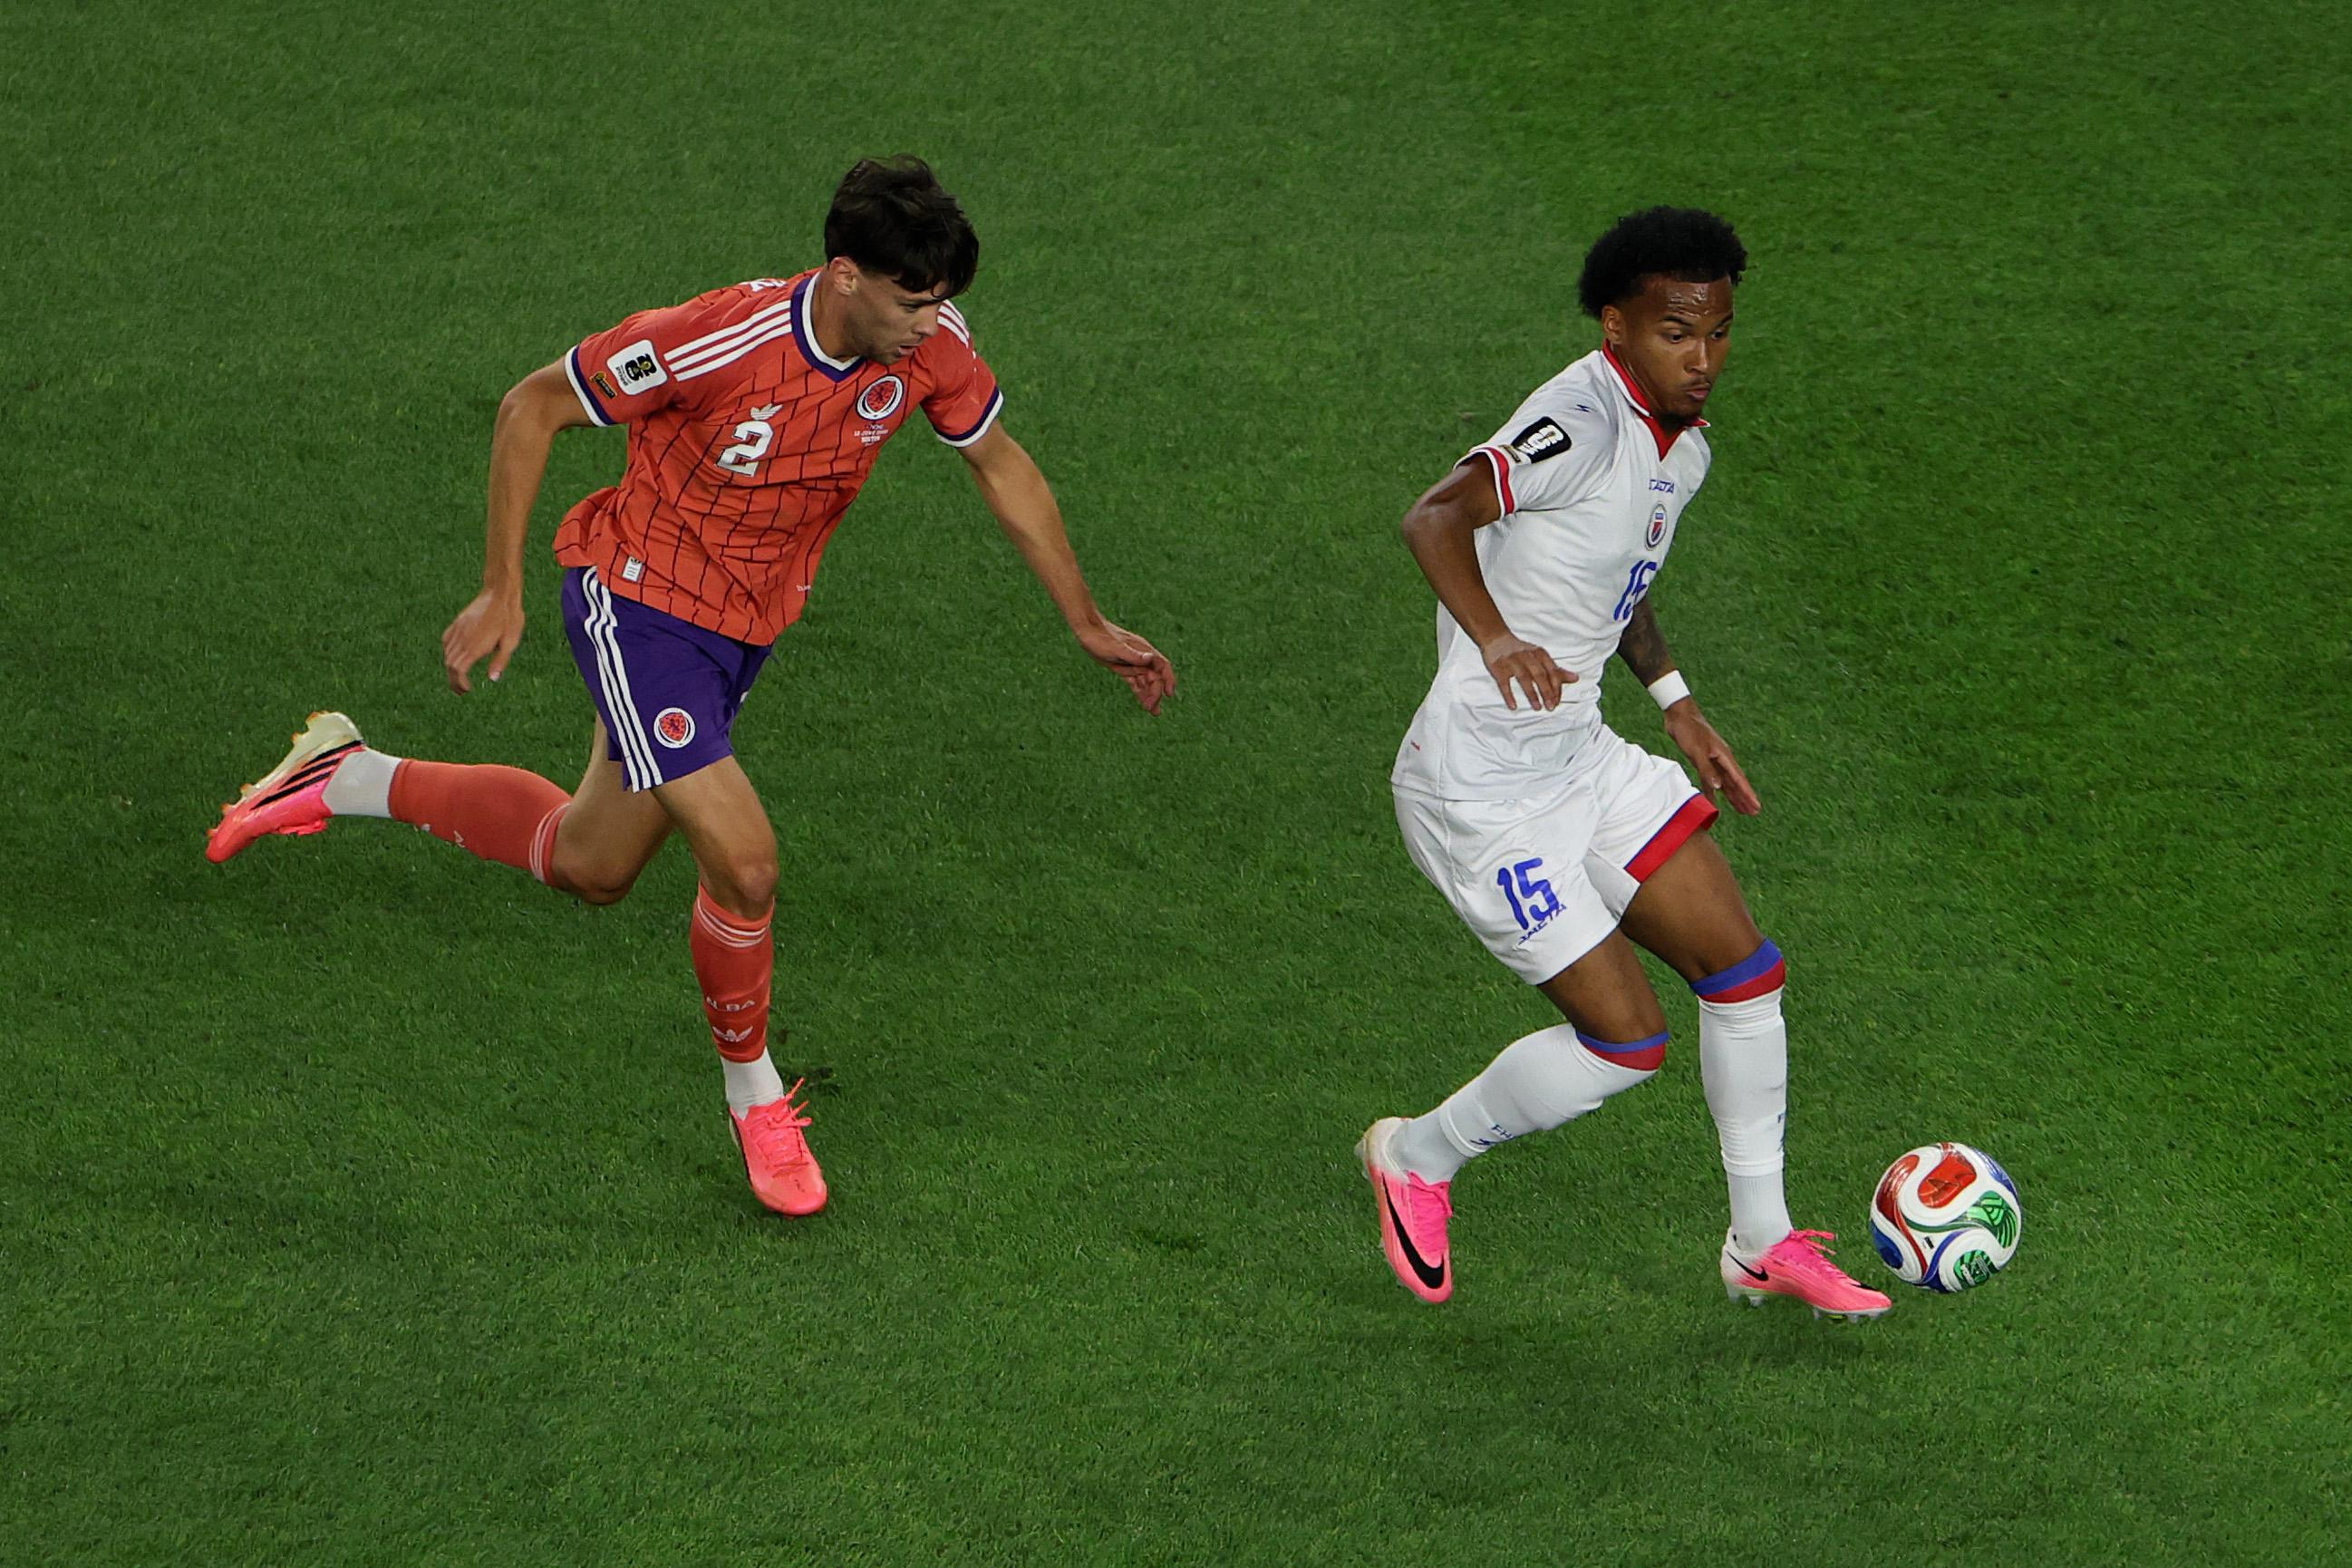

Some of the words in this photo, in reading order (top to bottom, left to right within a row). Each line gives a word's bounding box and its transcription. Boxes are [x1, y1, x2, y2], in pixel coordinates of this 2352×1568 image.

[714, 421, 775, 478] 2
[1613, 559, 1658, 621] 15
[1496, 857, 1559, 930] 15
